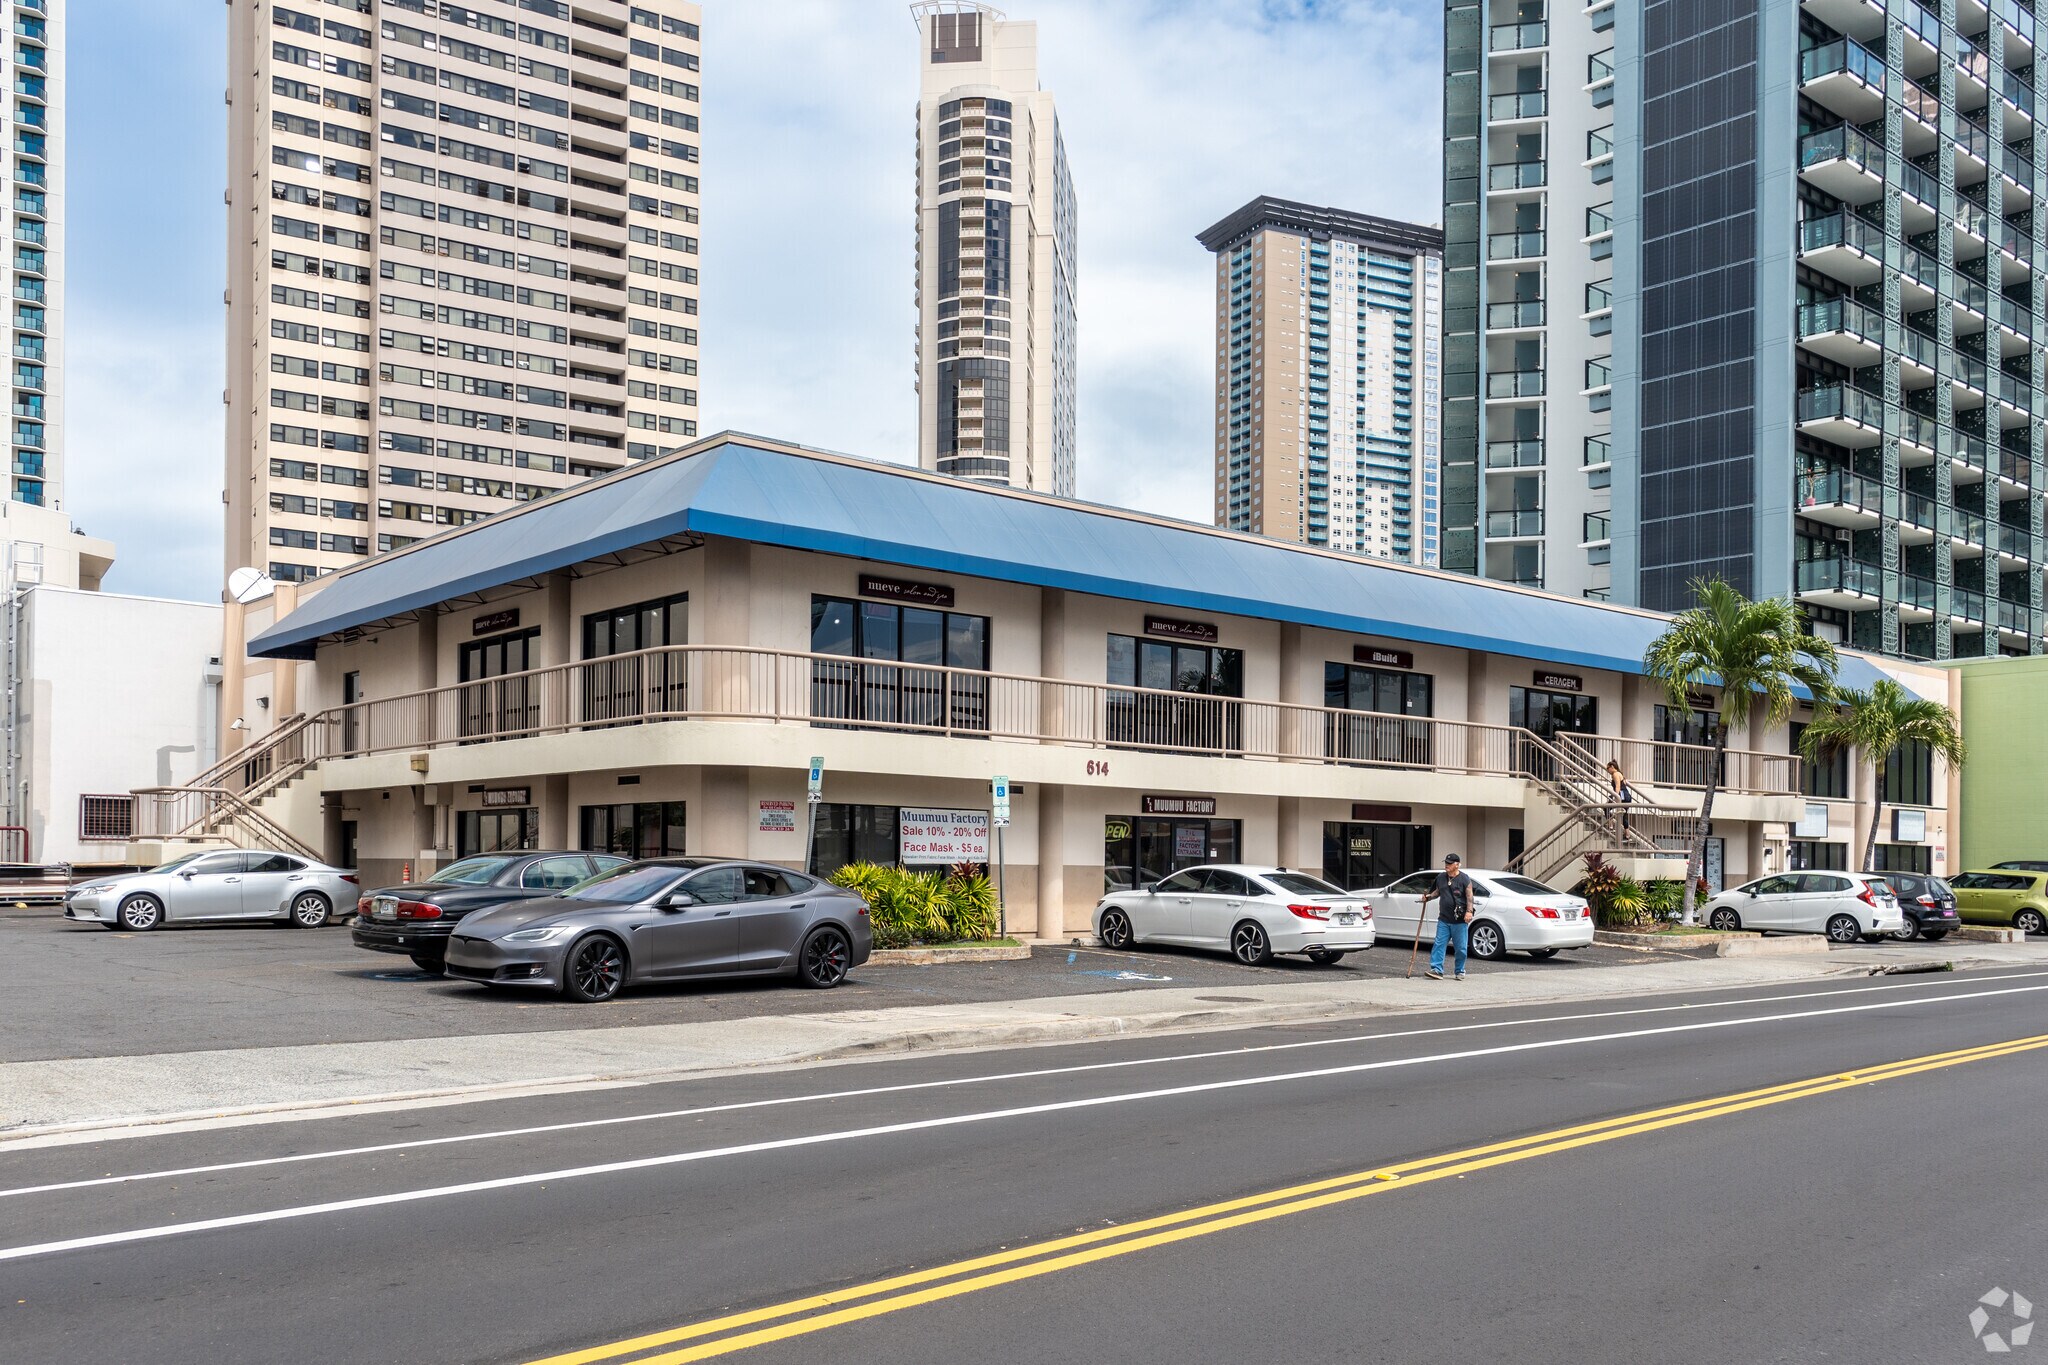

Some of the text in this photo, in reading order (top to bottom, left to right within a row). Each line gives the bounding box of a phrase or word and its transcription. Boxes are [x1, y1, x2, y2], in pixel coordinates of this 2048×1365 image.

[868, 581, 900, 593] nueve
[1152, 621, 1177, 632] nueve
[1372, 652, 1398, 664] iBuild
[1544, 676, 1576, 688] CERAGEM
[1086, 760, 1109, 776] 614
[1154, 799, 1184, 812] MUUMUU
[1186, 800, 1214, 813] FACTORY
[902, 811, 987, 826] Muumuu Factory
[902, 826, 924, 836] Sale
[926, 826, 945, 836] 10%
[954, 828, 972, 838] 20%
[974, 828, 987, 838] Off
[1105, 825, 1127, 839] PEN
[904, 842, 926, 852] Face
[930, 842, 954, 852] Mask
[962, 843, 972, 853] $5
[1178, 848, 1202, 856] ENTRANCE
